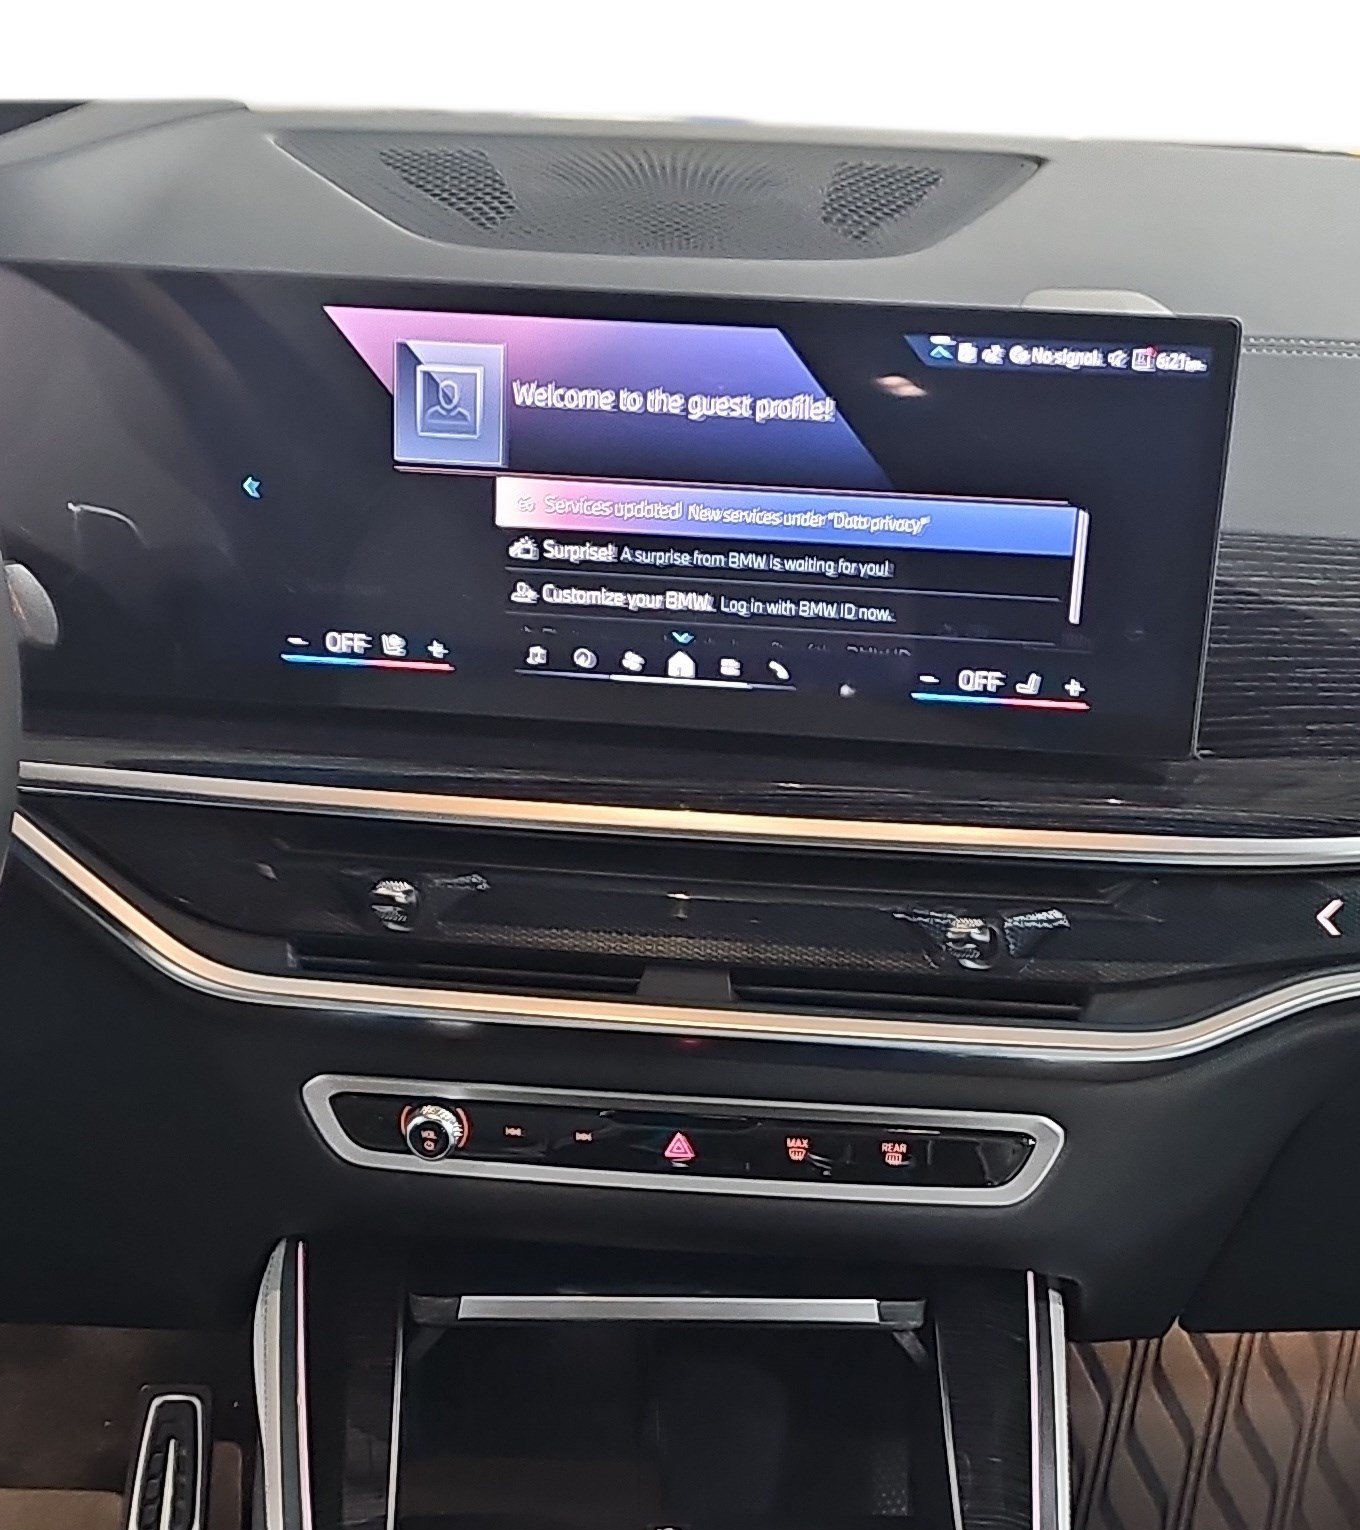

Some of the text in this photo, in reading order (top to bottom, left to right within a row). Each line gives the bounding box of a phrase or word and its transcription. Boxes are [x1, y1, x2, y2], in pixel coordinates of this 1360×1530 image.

[1031, 347, 1050, 365] No
[512, 379, 836, 422] Welcome to the guest profile!
[544, 495, 614, 516] Services
[687, 502, 721, 521] New
[722, 506, 783, 526] services
[783, 508, 827, 527] under
[543, 539, 618, 563] Surprise!
[620, 546, 633, 561] A
[635, 549, 693, 568] surprise
[693, 549, 724, 567] from
[728, 552, 768, 569] BMW
[769, 554, 782, 570] is
[784, 555, 837, 577] waiting
[838, 558, 857, 575] for
[542, 583, 628, 608] Customize
[627, 594, 664, 611] your
[720, 595, 750, 617] Log
[750, 597, 764, 613] in
[766, 600, 797, 616] with
[798, 601, 839, 619] BMW
[840, 604, 857, 620] ID
[858, 606, 896, 623] now.
[325, 631, 373, 654] OFF
[958, 669, 1006, 692] OFF
[786, 1137, 809, 1149] MAX
[881, 1142, 907, 1154] REAR
